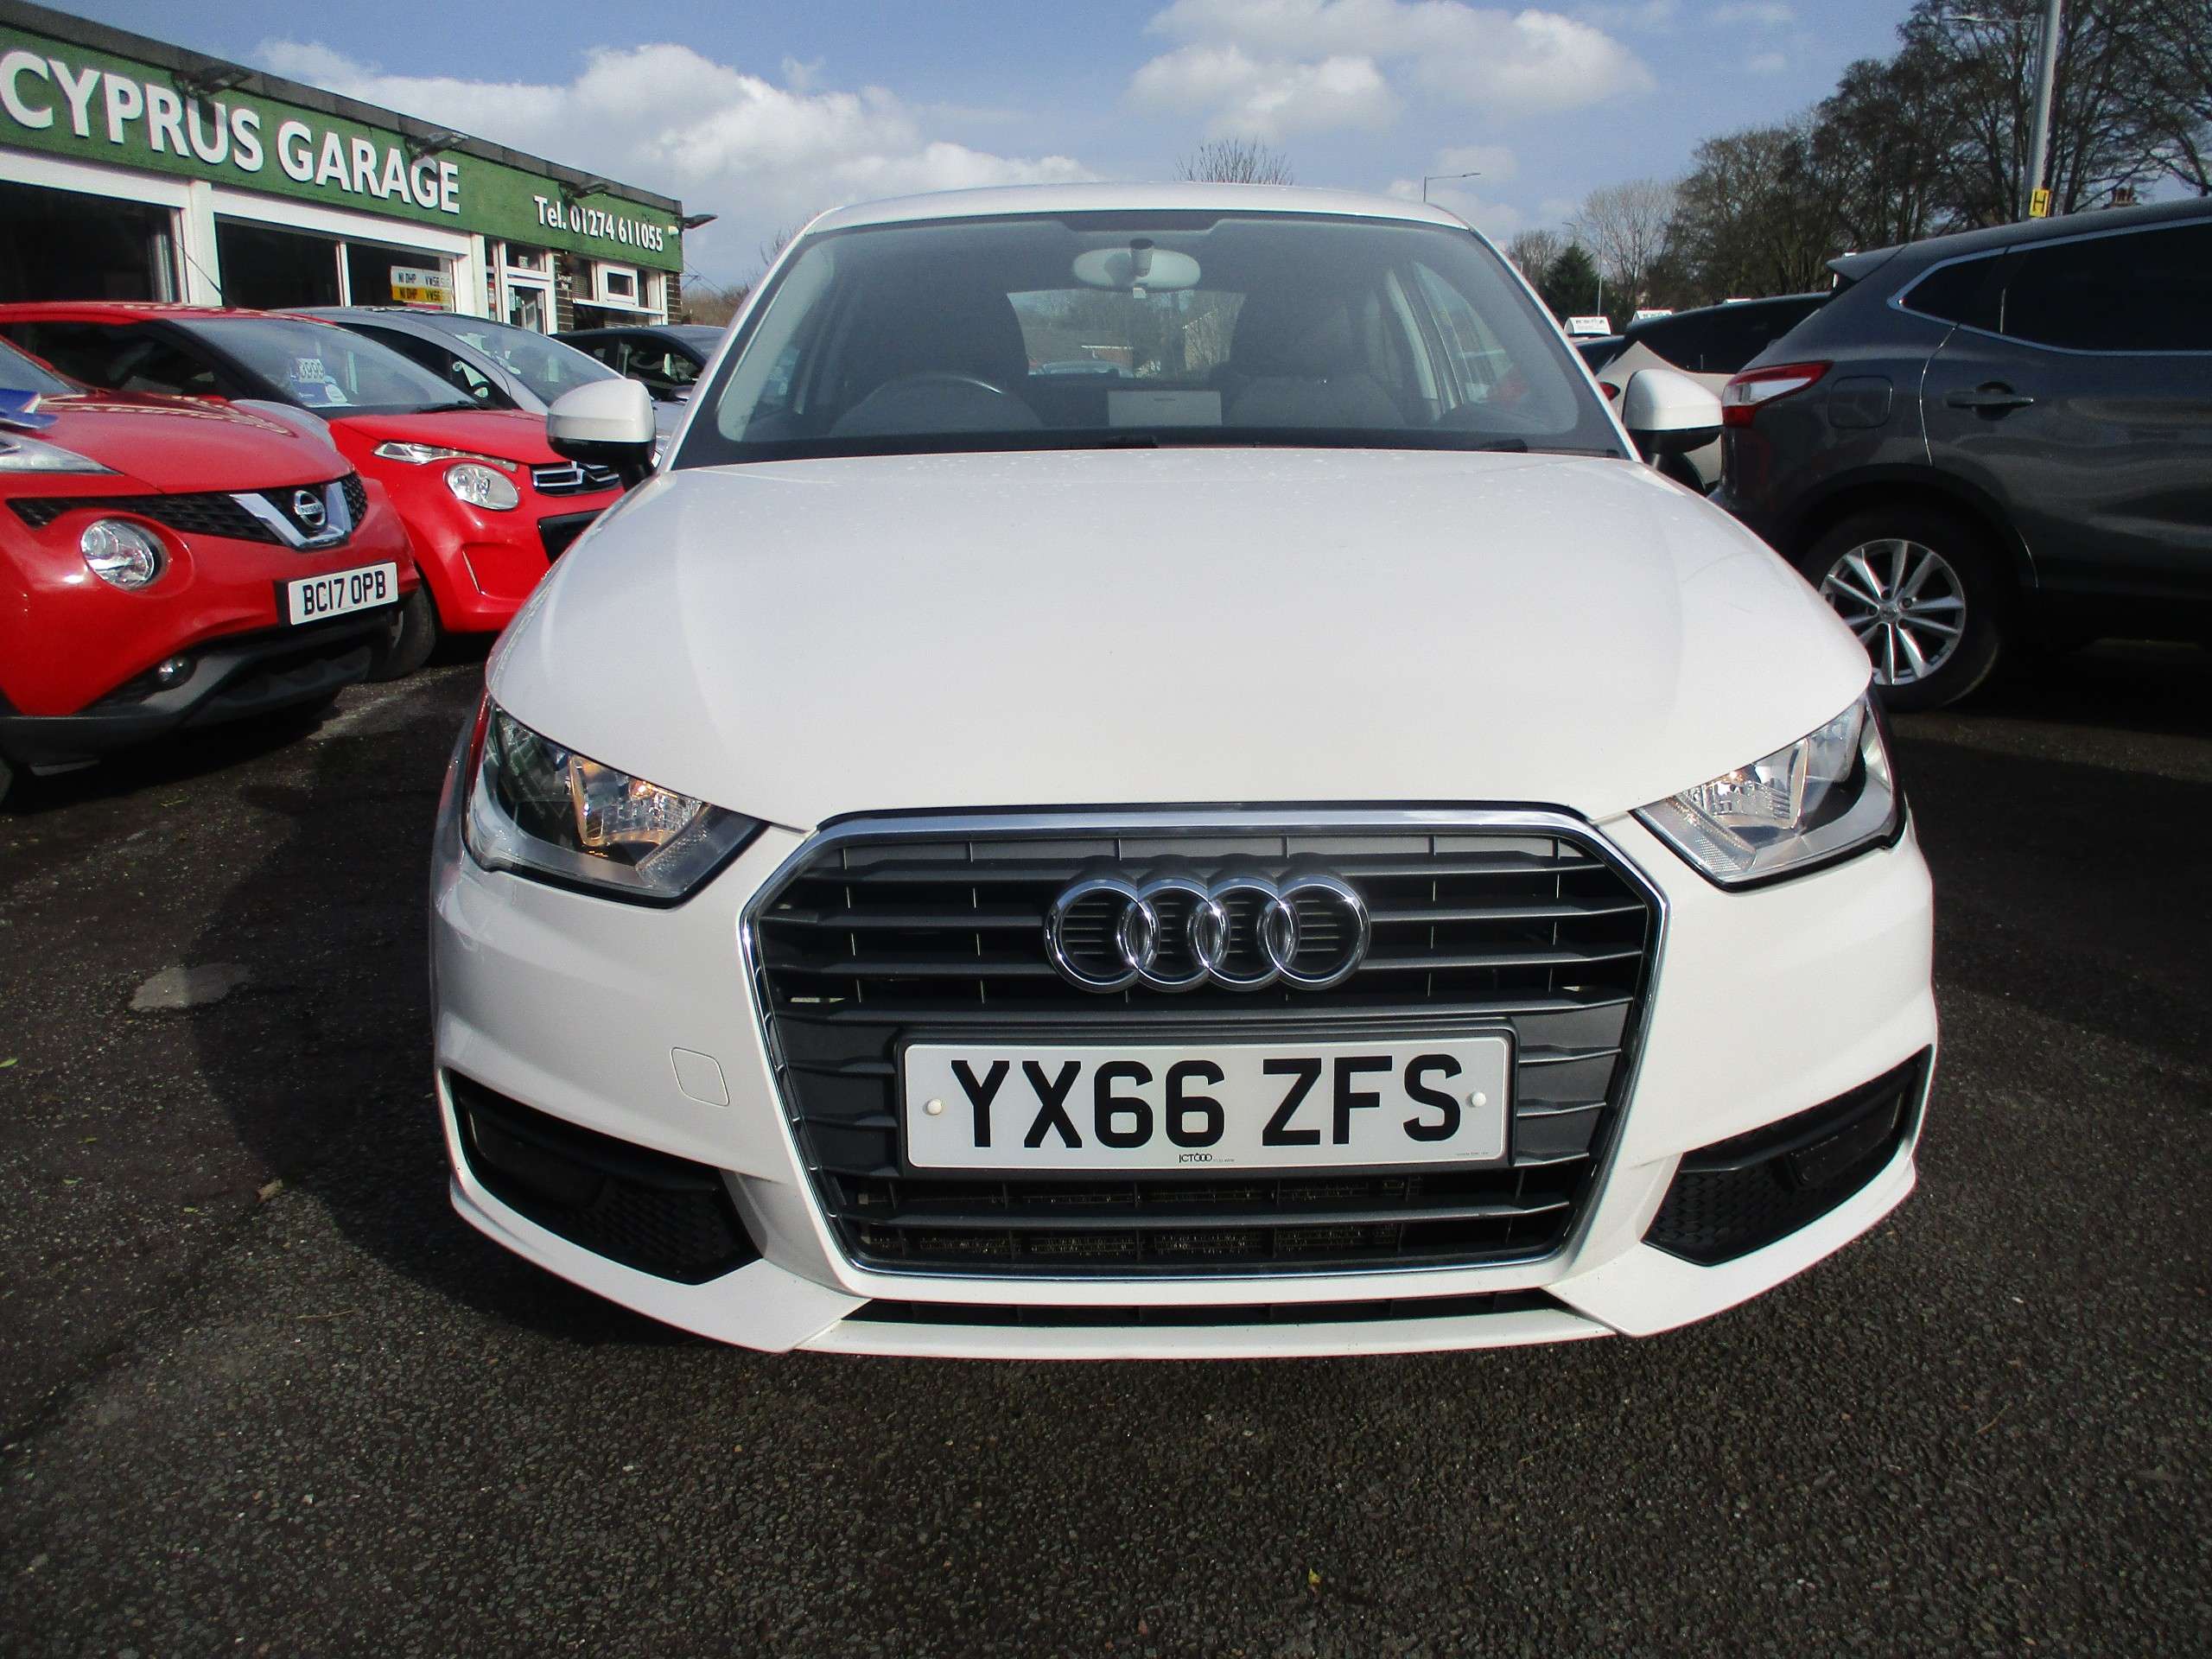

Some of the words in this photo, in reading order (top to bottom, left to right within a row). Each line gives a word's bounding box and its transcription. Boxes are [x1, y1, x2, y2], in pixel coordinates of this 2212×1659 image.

[0, 50, 264, 172] CYPRUS
[276, 120, 461, 215] GARAGE
[533, 194, 567, 231] Tel.
[569, 205, 615, 241] 01274
[618, 217, 664, 252] 611055
[2032, 191, 2047, 213] H
[302, 578, 346, 616] BC17
[351, 570, 386, 605] OPB
[950, 1059, 1225, 1149] YX66
[1261, 1053, 1463, 1147] ZFS
